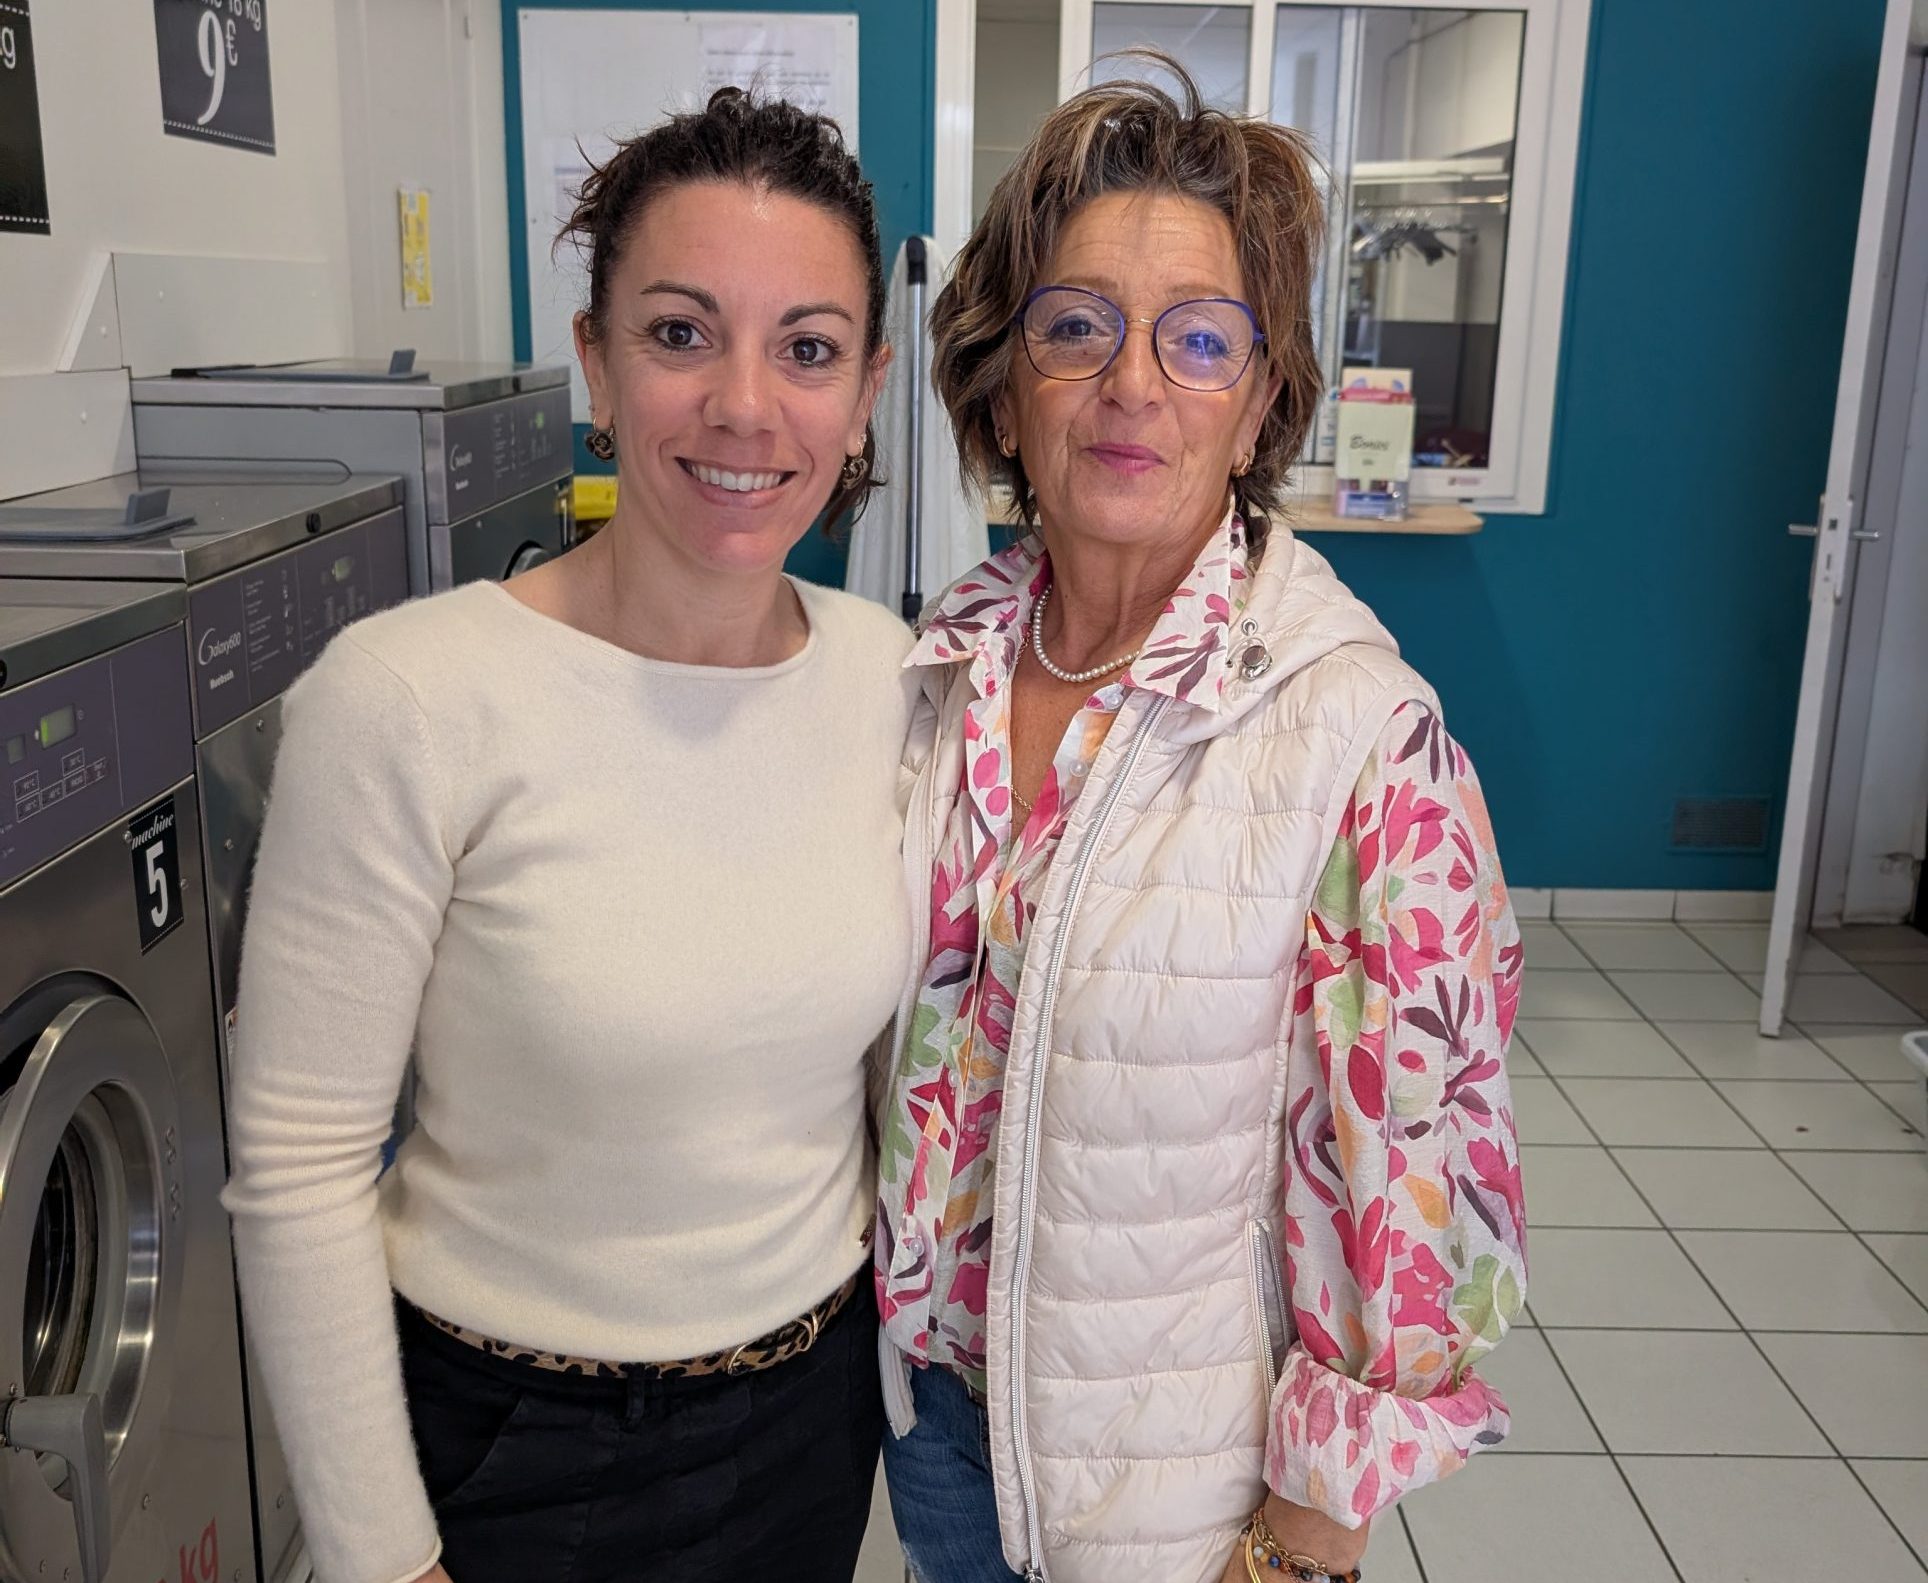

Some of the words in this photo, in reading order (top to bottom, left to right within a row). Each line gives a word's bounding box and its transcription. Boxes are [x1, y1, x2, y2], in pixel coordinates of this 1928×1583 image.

[0, 26, 17, 69] g
[131, 814, 174, 850] machine
[146, 840, 169, 928] 5
